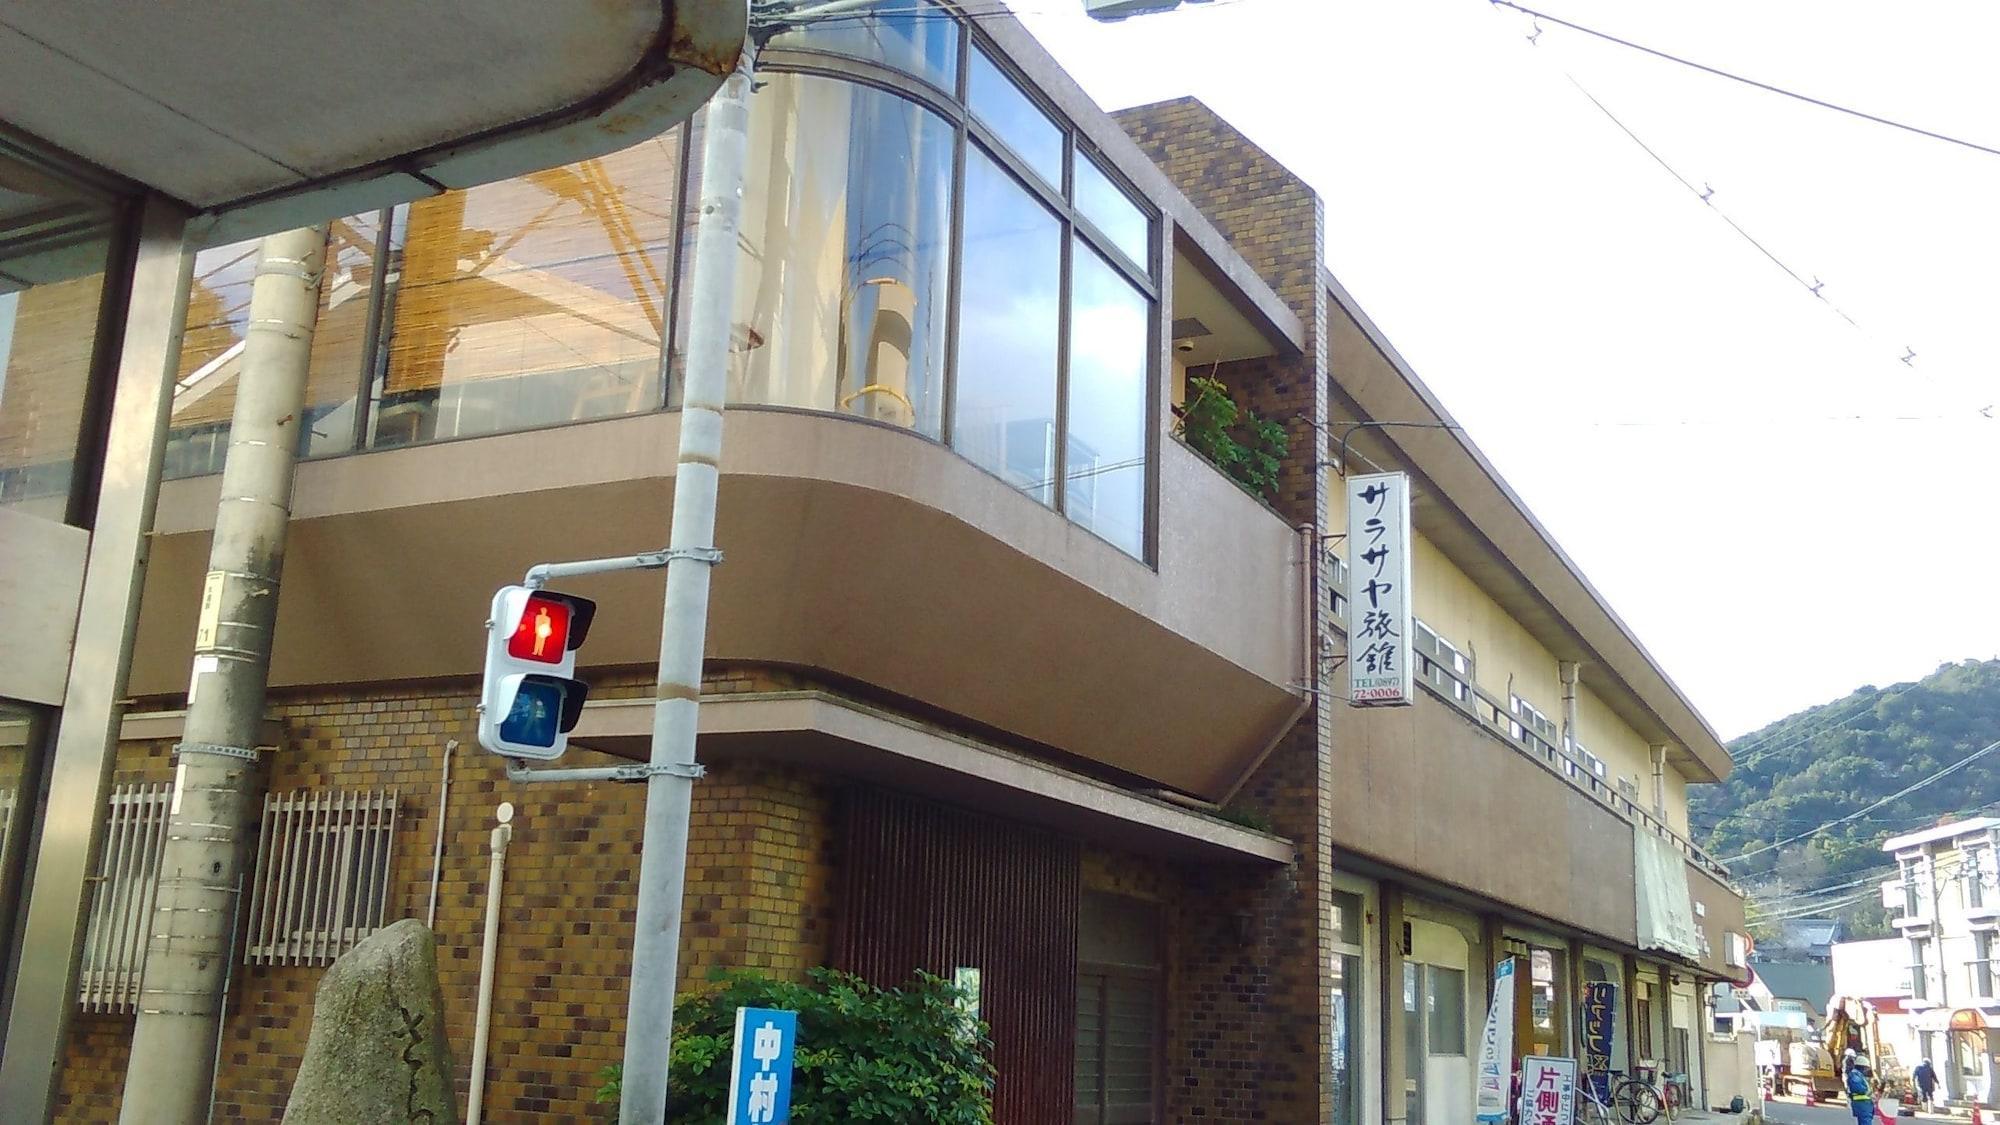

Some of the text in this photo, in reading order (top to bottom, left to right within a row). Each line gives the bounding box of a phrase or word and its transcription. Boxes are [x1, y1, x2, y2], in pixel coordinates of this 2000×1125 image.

[747, 1021, 782, 1125] 中村
[1560, 1074, 1572, 1125] 工事中につ
